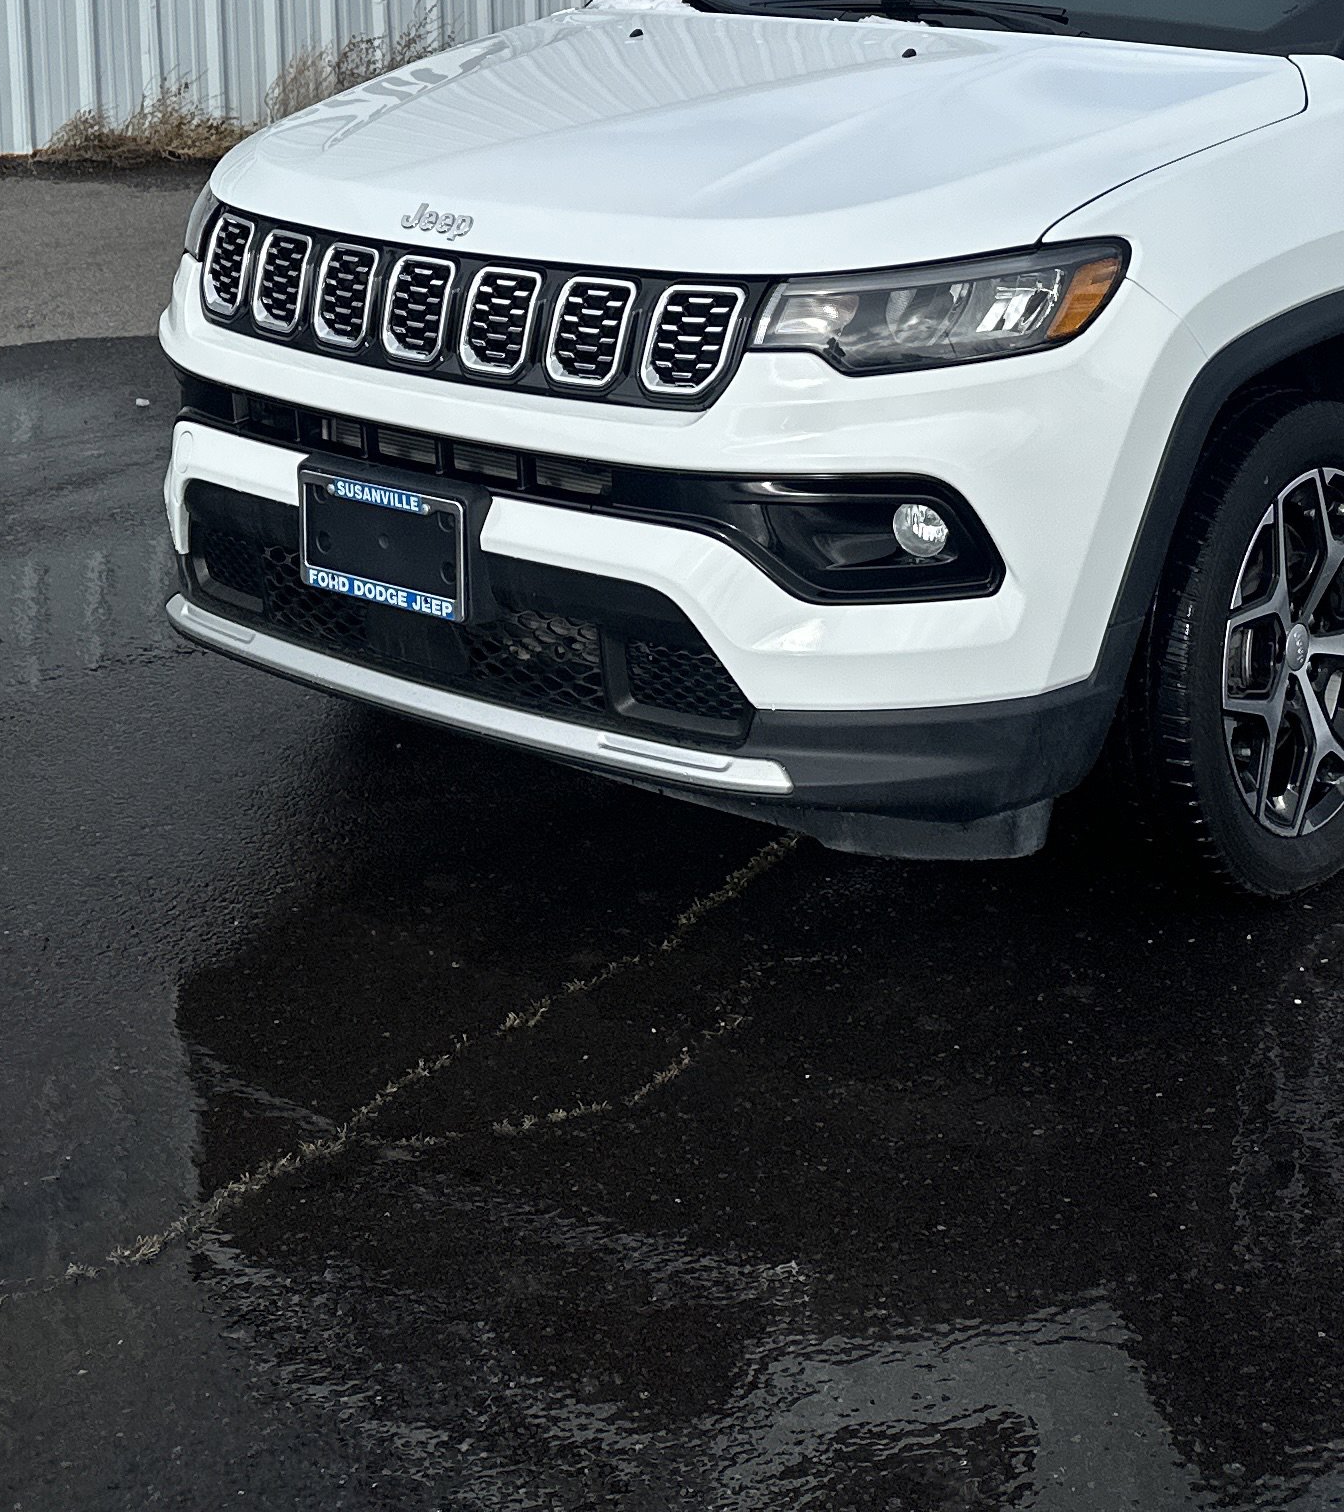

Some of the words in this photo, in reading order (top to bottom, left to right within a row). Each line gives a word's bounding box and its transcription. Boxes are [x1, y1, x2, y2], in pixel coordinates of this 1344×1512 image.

[400, 202, 474, 242] Jeep
[336, 480, 420, 512] SUSANVILLE
[308, 568, 350, 593] FORD
[353, 579, 408, 608] DODGE
[412, 594, 454, 618] JEEP
